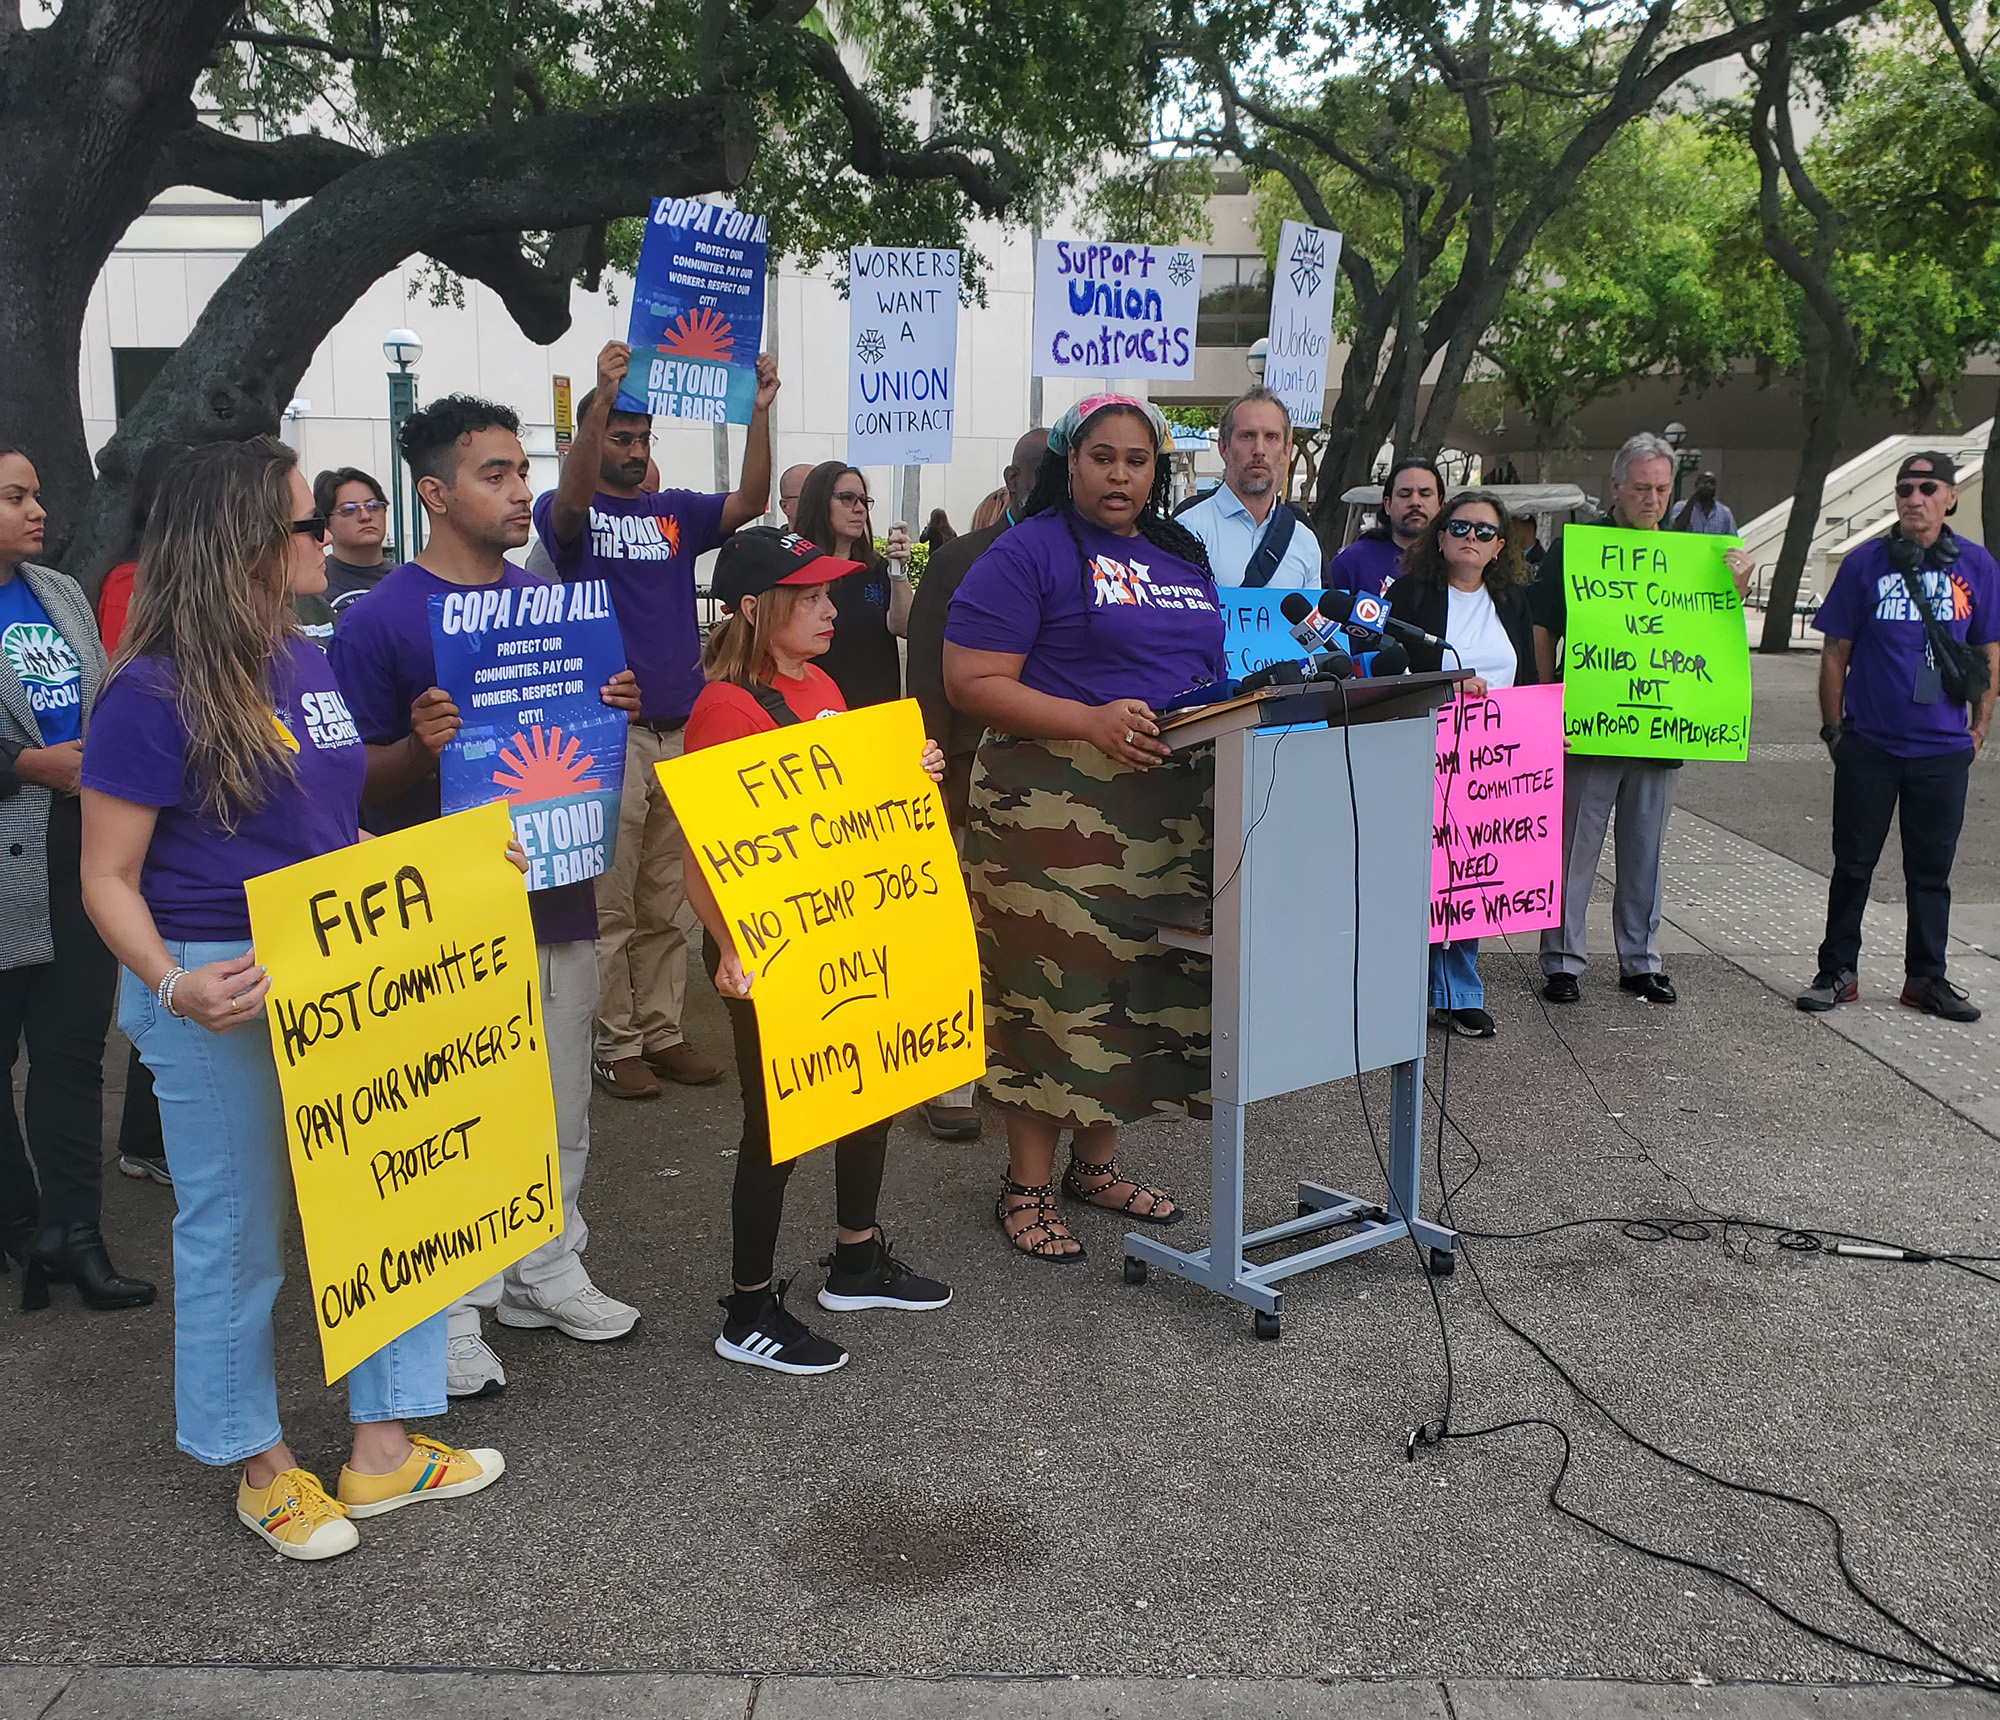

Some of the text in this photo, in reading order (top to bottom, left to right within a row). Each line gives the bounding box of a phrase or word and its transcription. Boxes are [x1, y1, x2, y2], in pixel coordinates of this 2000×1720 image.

[654, 197, 713, 233] COPA
[713, 208, 755, 242] FOR
[673, 255, 753, 279] COMMUNITIES. PAY OUR
[695, 242, 744, 261] PROTECT OUR
[854, 251, 955, 278] WORKERS
[669, 271, 751, 295] WORKERS. RESPECT OUR
[699, 295, 718, 307] CITY!
[877, 290, 942, 314] WANT
[900, 321, 915, 343] A
[1272, 305, 1327, 358] Workers
[648, 358, 728, 398] BEYOND
[860, 367, 948, 403] UNION
[647, 391, 727, 423] THE BARS
[855, 409, 954, 435] CONTRACT
[591, 531, 624, 559] THE
[1601, 545, 1667, 573] FIFA
[442, 579, 610, 635] COPA FOR ALL!
[1148, 584, 1204, 598] Beyond
[1156, 597, 1184, 609] the
[1572, 574, 1737, 615] HOST COMMITTEE
[1375, 604, 1389, 628] NEWS
[1625, 613, 1664, 635] USE
[497, 637, 562, 657] PROTECT OUR
[474, 657, 583, 684] COMMUNITIES. PAY OUR
[1650, 648, 1713, 683] LABOR
[472, 680, 584, 708] WORKERS. RESPECT OUR
[1629, 678, 1669, 702] NOT
[301, 690, 352, 726] SEIU
[518, 709, 544, 725] CITY!
[1564, 711, 1747, 751] LOW ROAD EMPLOYERS!
[1469, 743, 1521, 772] HOST
[737, 743, 843, 808] FIFA
[1467, 768, 1554, 800] COMMITTEE
[510, 800, 604, 857] EYOND
[702, 793, 936, 884] HOST COMMITTEE
[1466, 815, 1548, 850] WORKERS
[552, 844, 605, 886] BARS
[1451, 853, 1498, 878] NEED
[309, 864, 433, 957] FIFA
[737, 860, 938, 959] NO TEMP JOBS
[1430, 880, 1554, 927] IVING WAGES!
[819, 944, 889, 999] ONLY
[275, 936, 508, 1067] HOST COMMITTEE
[876, 989, 974, 1074] WAGES!
[296, 980, 536, 1161] PAY OUR WORKERS!
[370, 1116, 482, 1201] PROTECT
[321, 1153, 555, 1330] OUR COMMUNITIES!
